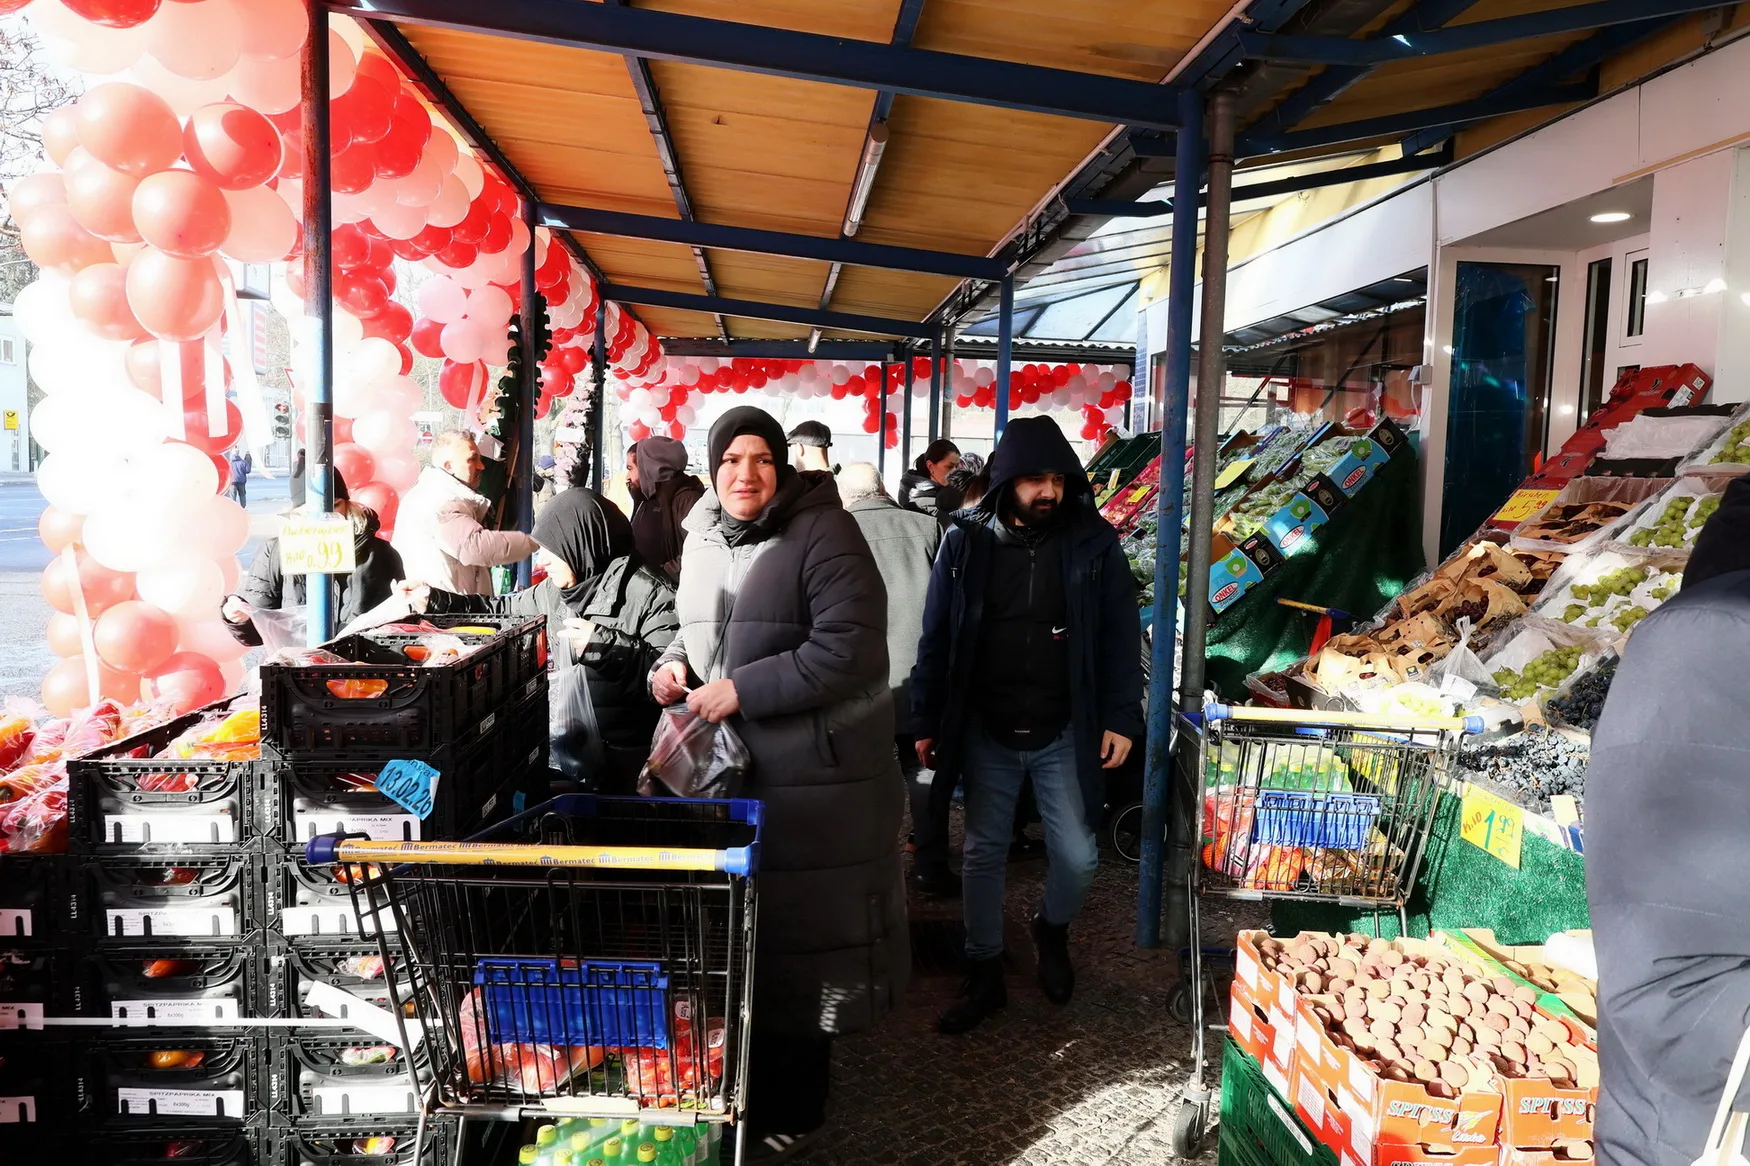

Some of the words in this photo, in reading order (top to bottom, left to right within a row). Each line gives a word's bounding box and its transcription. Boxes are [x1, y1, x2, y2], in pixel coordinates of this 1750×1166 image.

[1344, 468, 1365, 488] ONKEL
[1214, 584, 1238, 602] ONKEL
[380, 766, 432, 815] 13.02.26
[413, 843, 457, 851] Bermatec
[552, 857, 596, 866] Bermatec
[611, 855, 654, 864] Bermatec
[267, 891, 275, 916] LL4314
[270, 1074, 278, 1099] LL4314
